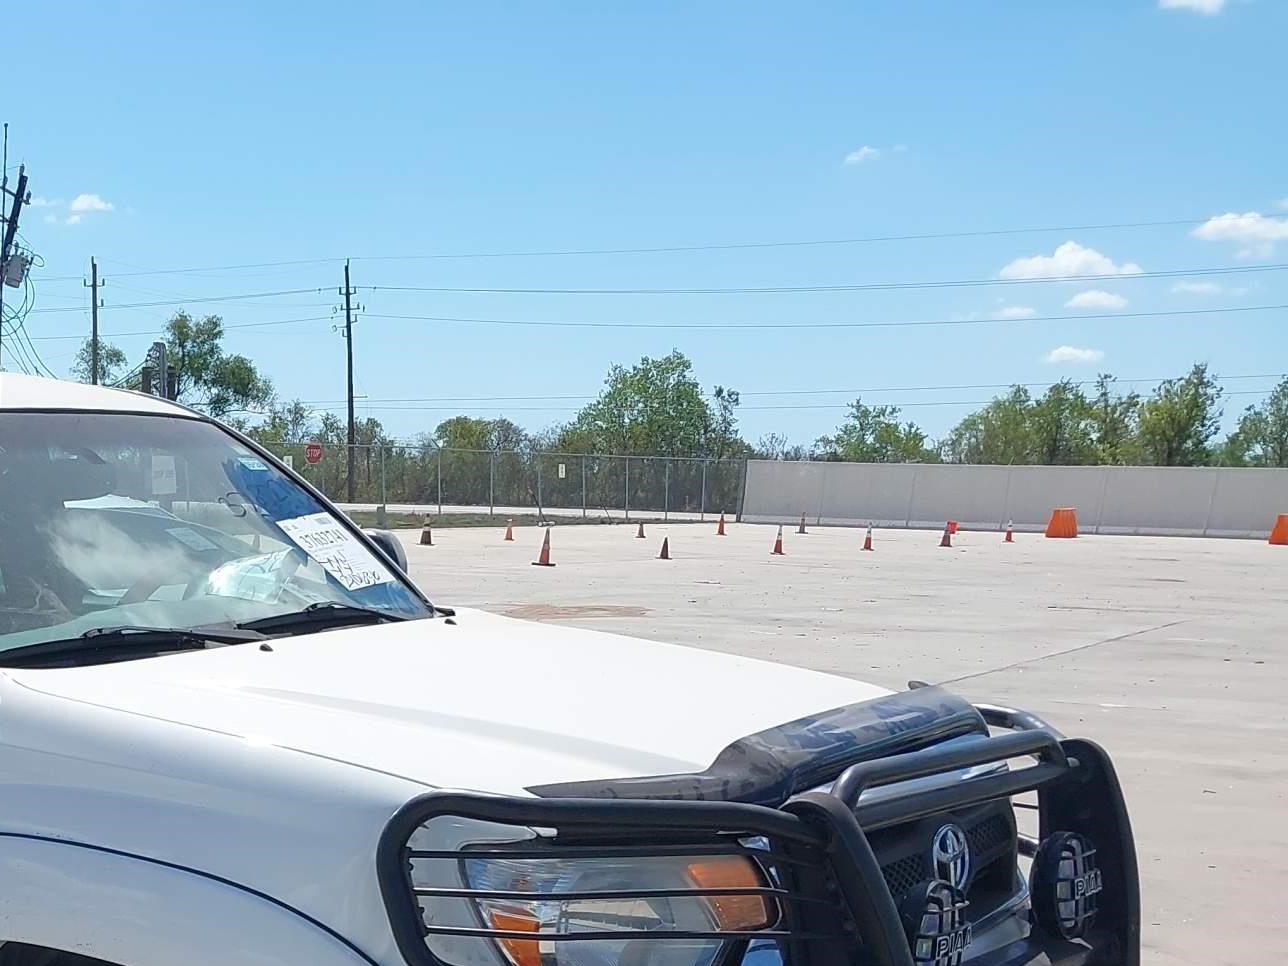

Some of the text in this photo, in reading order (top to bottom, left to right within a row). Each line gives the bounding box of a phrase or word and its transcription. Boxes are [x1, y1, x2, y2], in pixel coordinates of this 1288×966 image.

[306, 448, 321, 458] STOP
[299, 529, 348, 549] 37632741
[935, 925, 972, 960] PIAA
